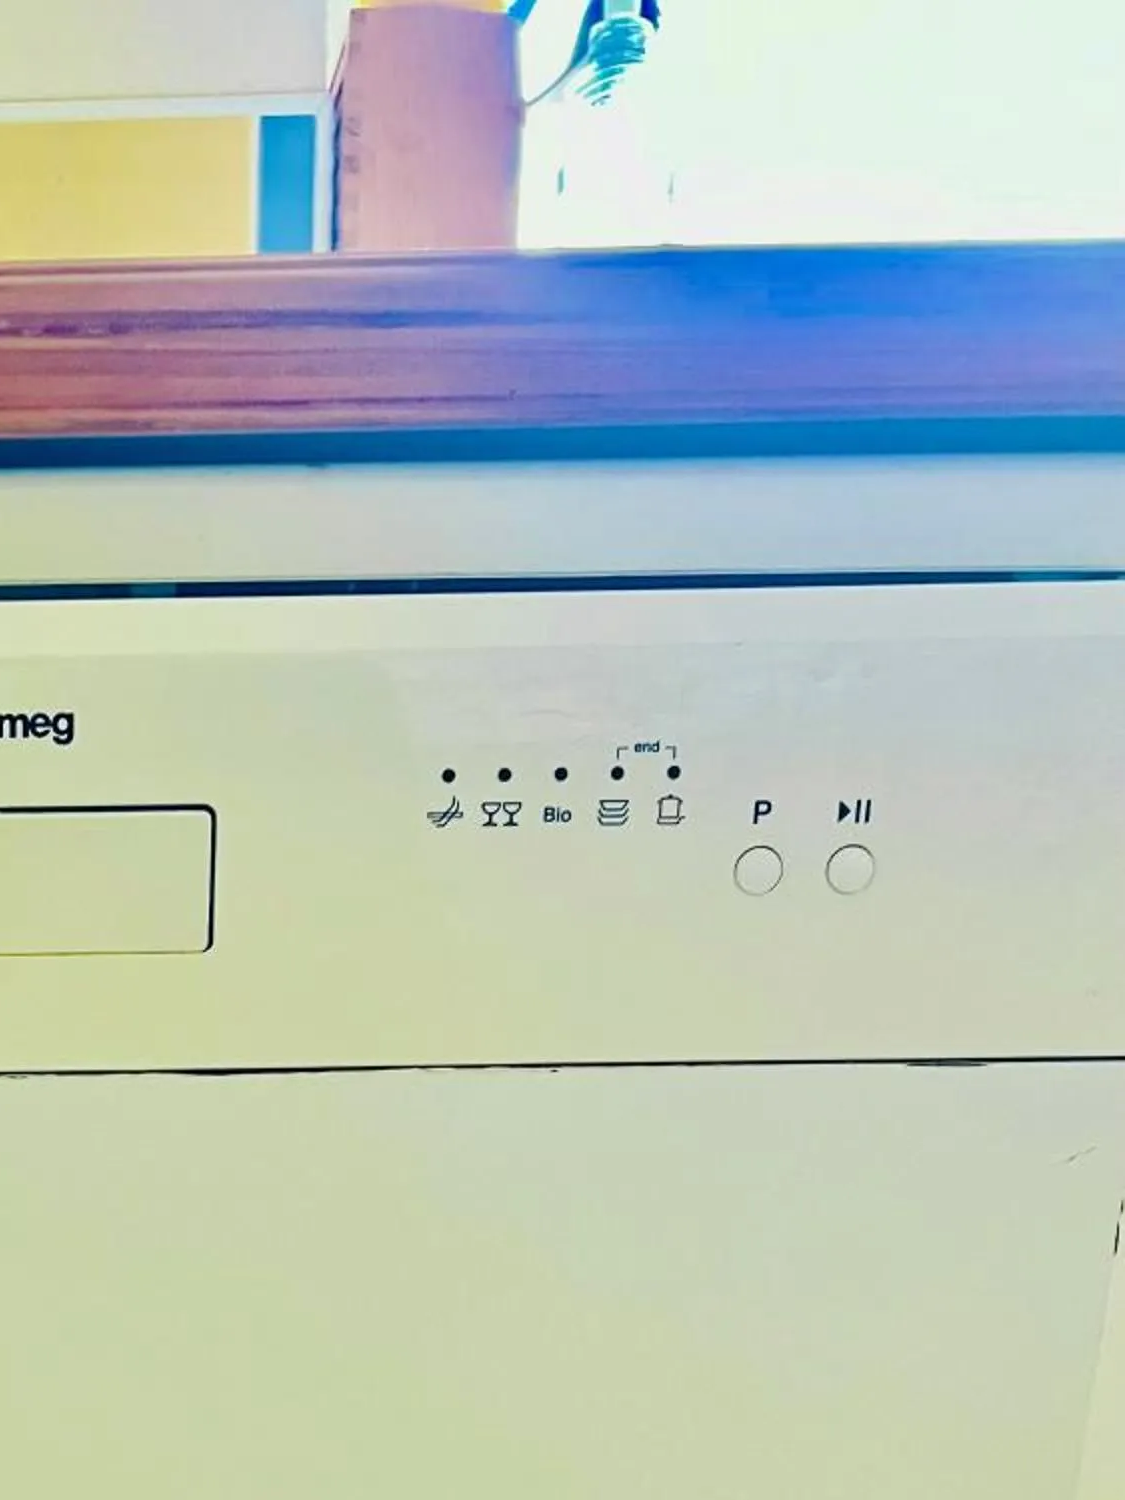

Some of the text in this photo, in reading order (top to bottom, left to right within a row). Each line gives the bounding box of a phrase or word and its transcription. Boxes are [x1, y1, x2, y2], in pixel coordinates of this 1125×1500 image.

[633, 739, 661, 754] end
[542, 805, 573, 824] Bio
[752, 800, 773, 825] P
